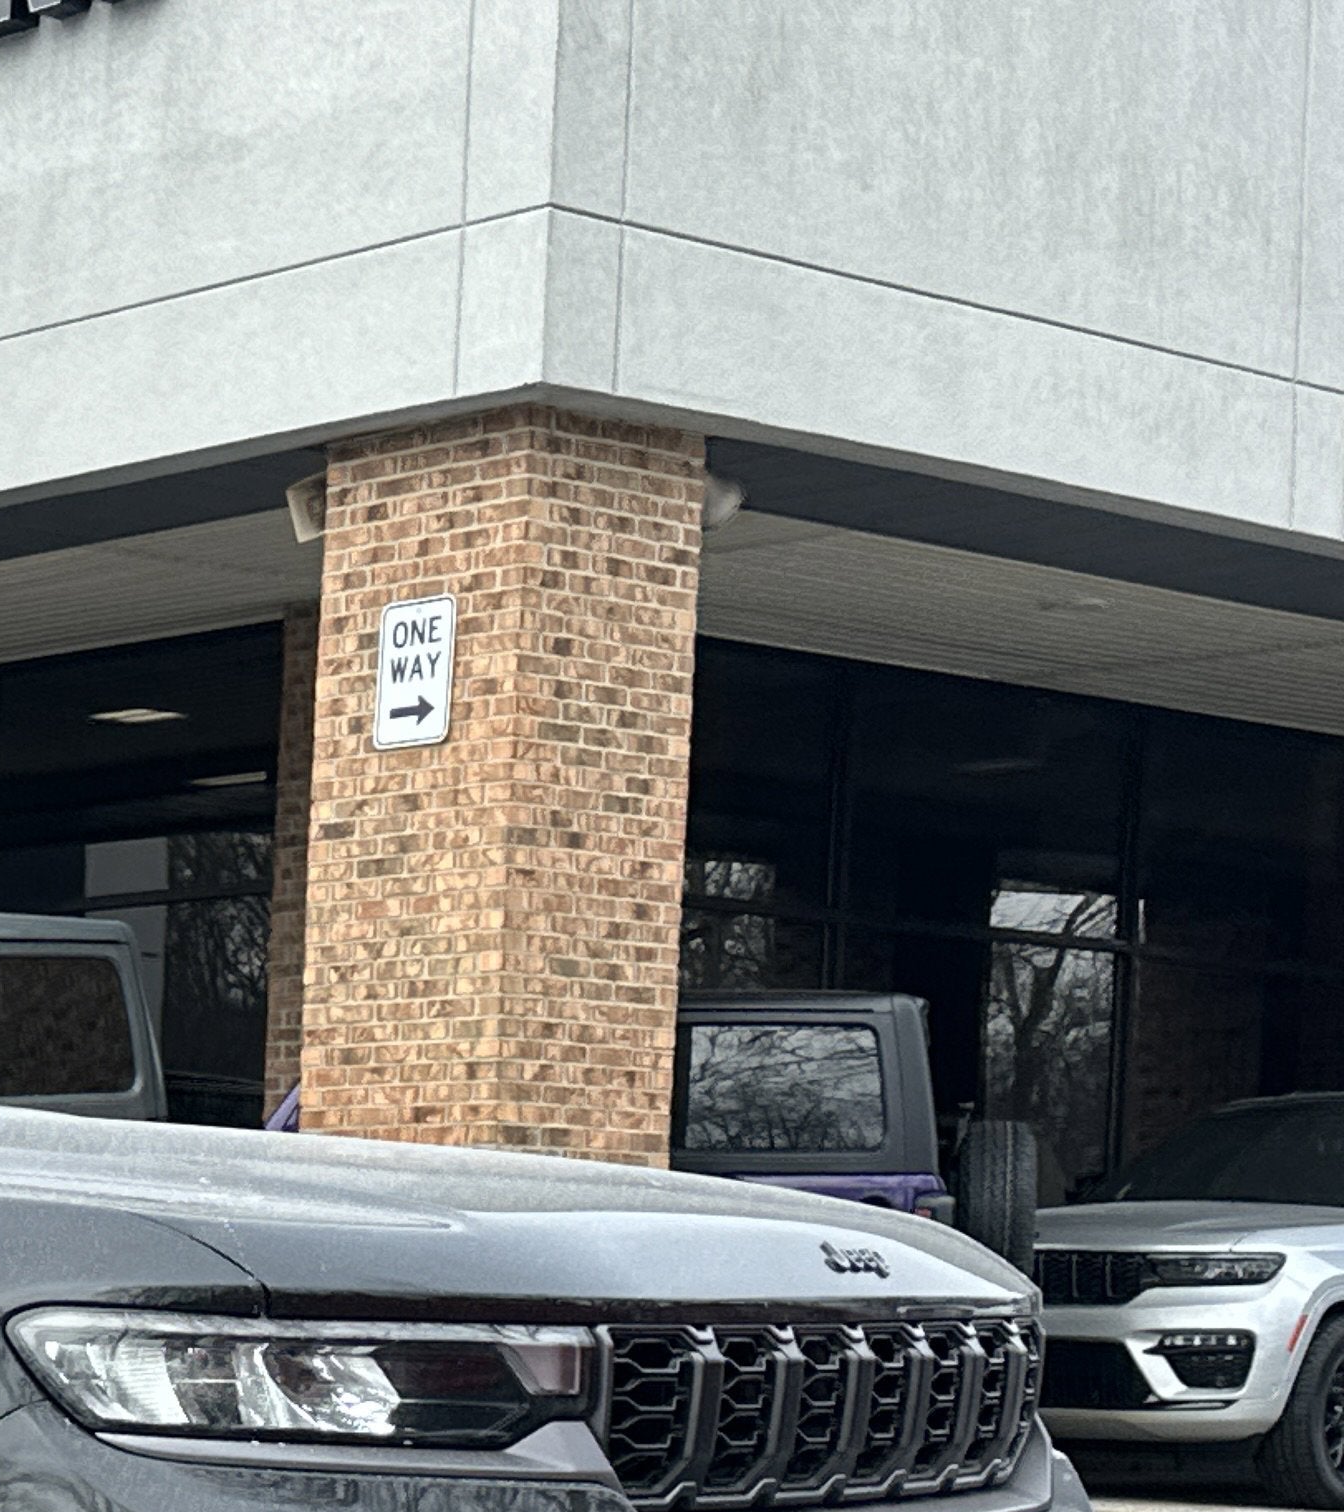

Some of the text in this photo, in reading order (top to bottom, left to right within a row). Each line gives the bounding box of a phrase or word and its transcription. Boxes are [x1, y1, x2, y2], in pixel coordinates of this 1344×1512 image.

[392, 615, 442, 648] ONE
[390, 650, 442, 684] WAY
[819, 1240, 890, 1279] Jeep
